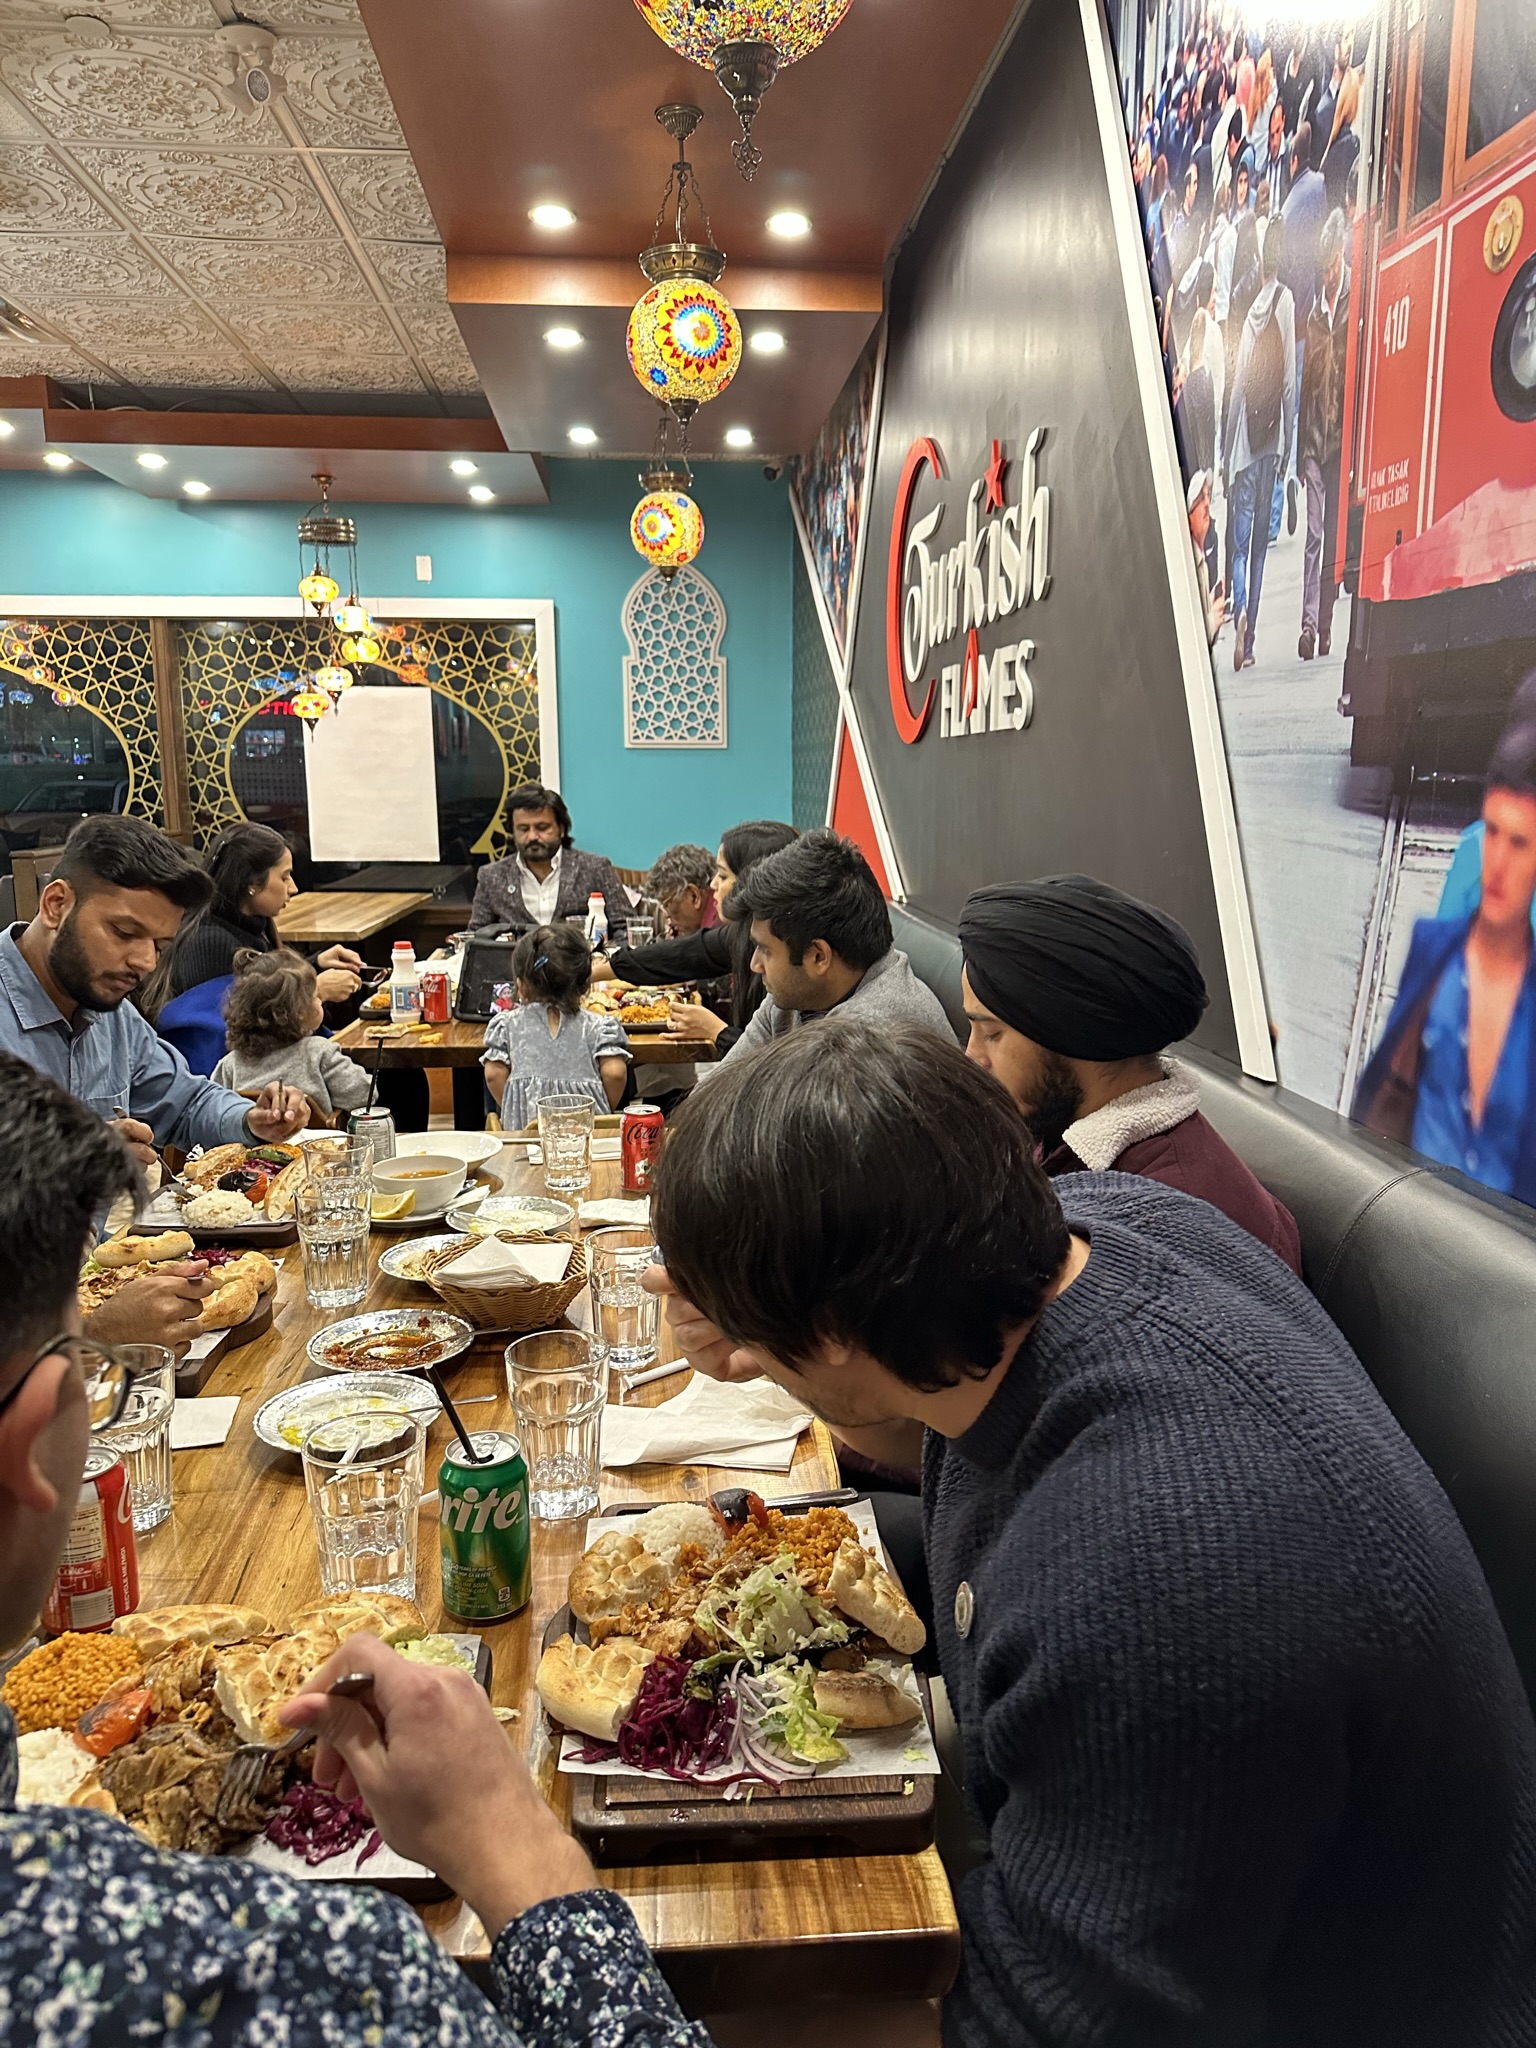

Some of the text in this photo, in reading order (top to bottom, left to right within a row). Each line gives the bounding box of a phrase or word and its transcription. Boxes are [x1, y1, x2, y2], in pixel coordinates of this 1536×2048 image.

[1383, 295, 1411, 357] 410
[904, 427, 1051, 682] Turkish
[940, 630, 1035, 738] FLAMES
